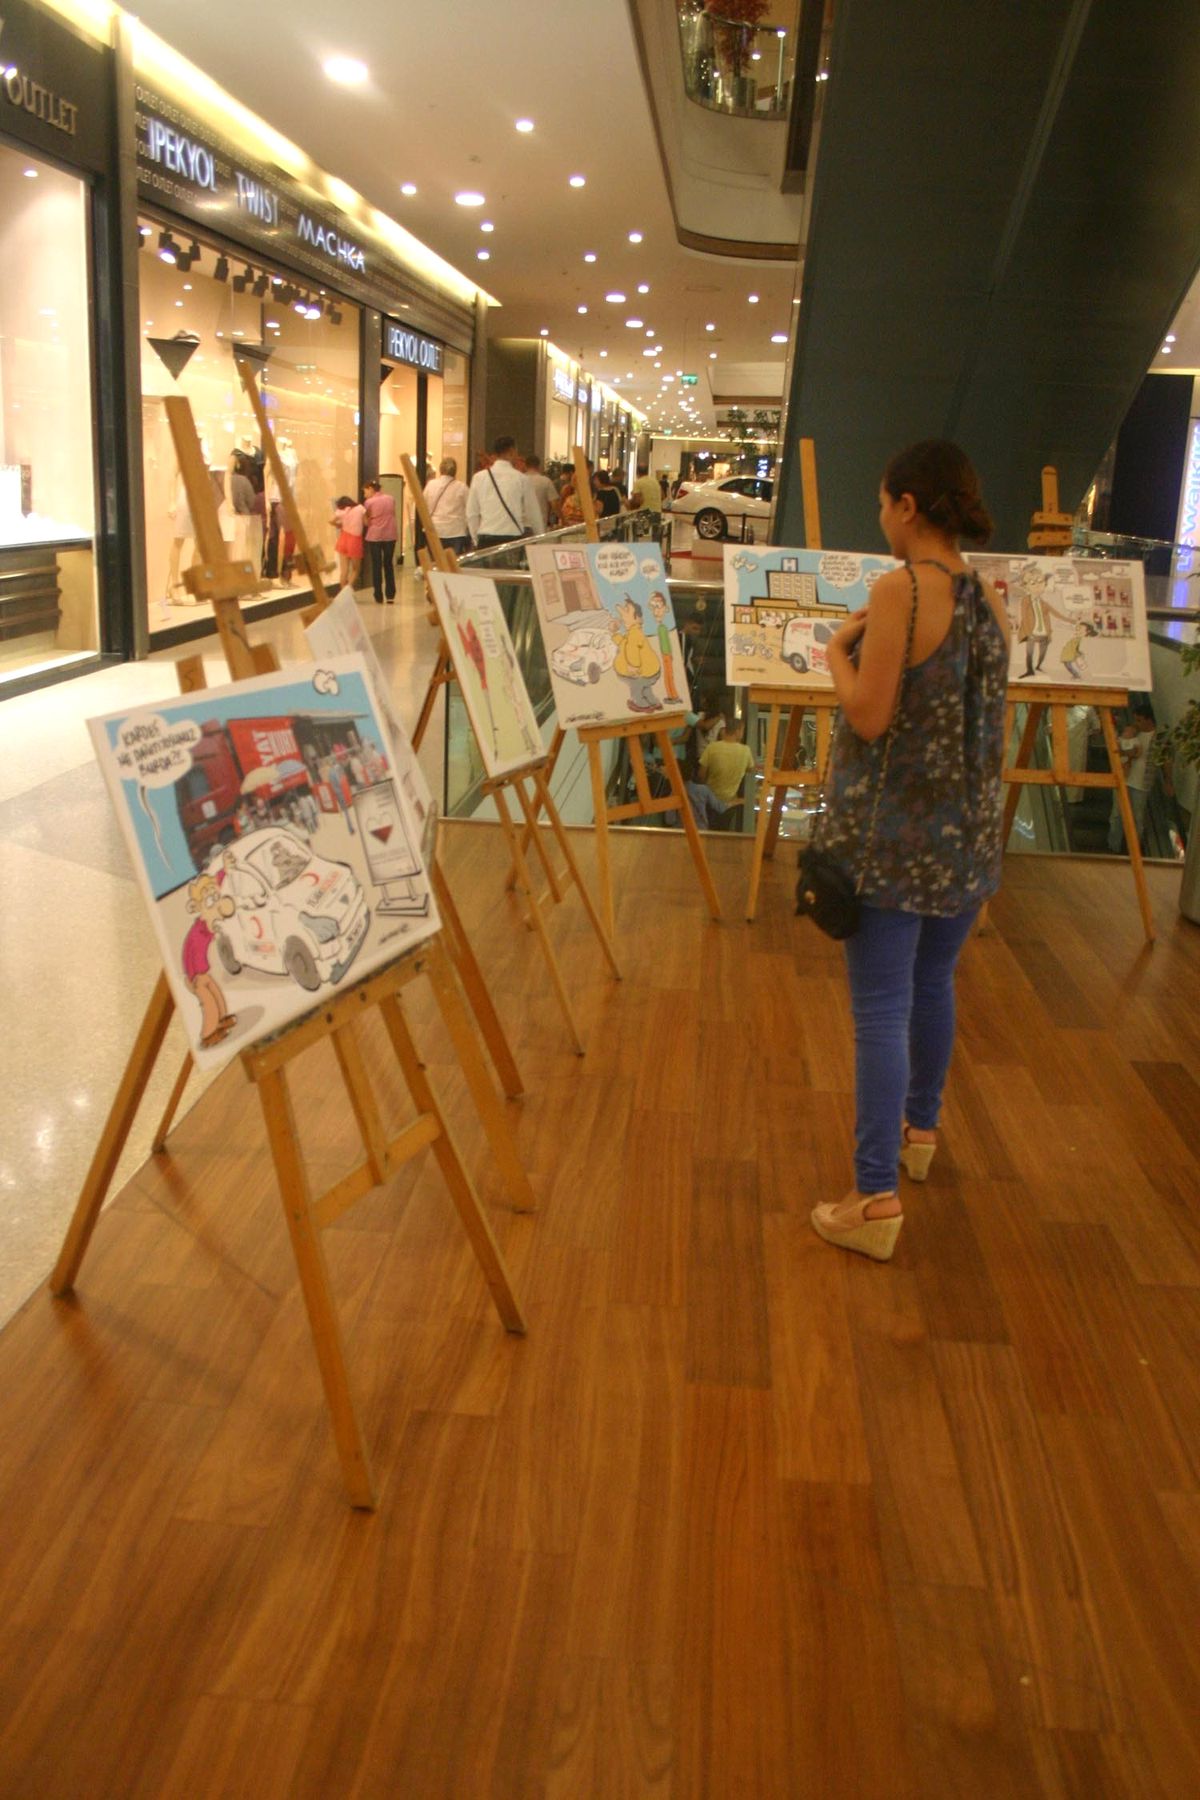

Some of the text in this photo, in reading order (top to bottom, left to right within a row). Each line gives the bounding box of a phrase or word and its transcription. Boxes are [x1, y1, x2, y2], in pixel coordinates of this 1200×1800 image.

[7, 72, 78, 135] OUTLET
[235, 171, 279, 228] TWIST
[298, 213, 366, 275] MACHKA
